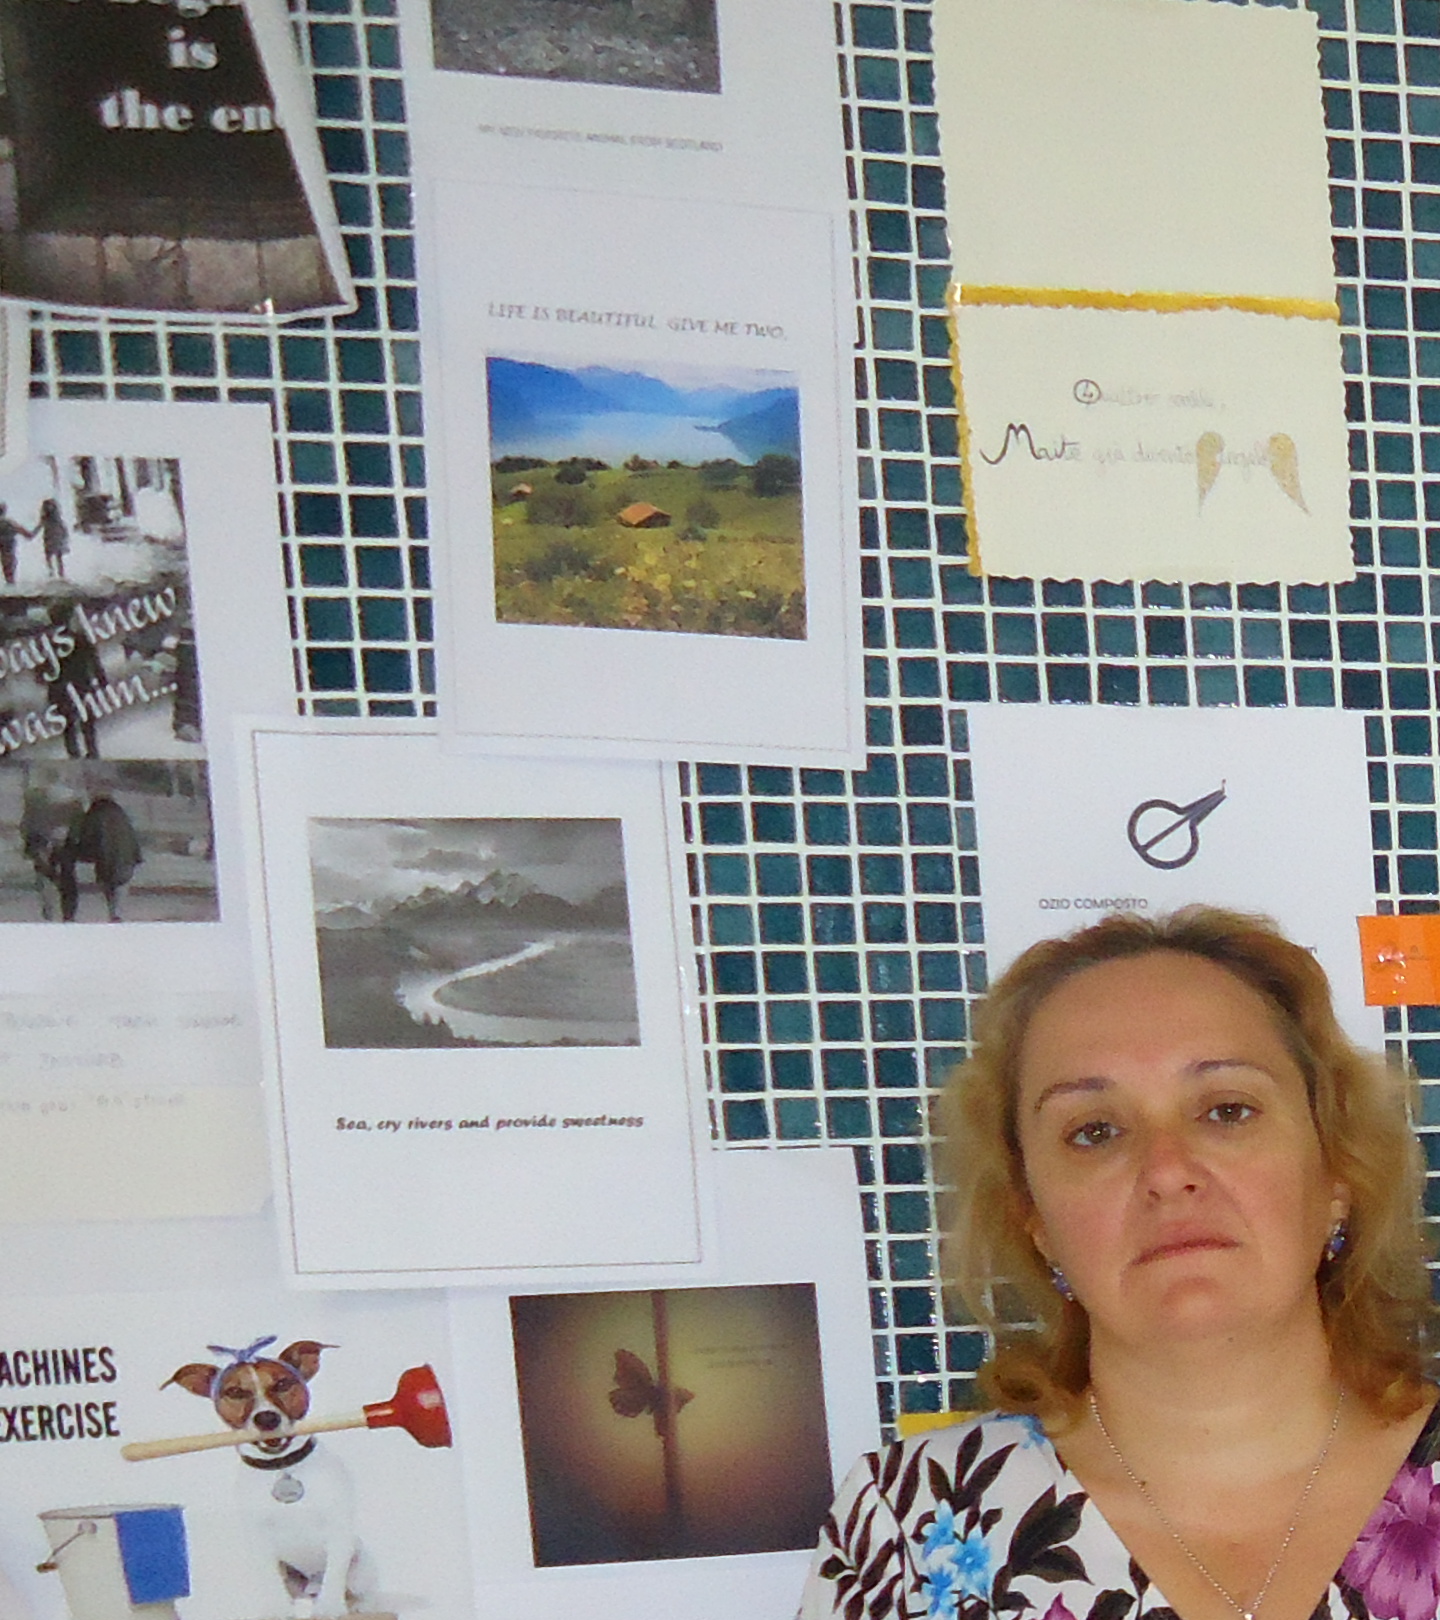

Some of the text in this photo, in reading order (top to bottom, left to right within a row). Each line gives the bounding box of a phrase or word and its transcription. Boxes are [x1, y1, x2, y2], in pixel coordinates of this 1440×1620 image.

[167, 25, 219, 70] is
[100, 86, 278, 132] the en
[76, 587, 176, 645] knew
[376, 1118, 402, 1133] cry
[408, 1116, 453, 1131] rivers
[458, 1115, 490, 1130] and
[495, 1115, 557, 1133] provide
[562, 1114, 644, 1130] sweetness
[0, 1346, 117, 1388] ACHINES
